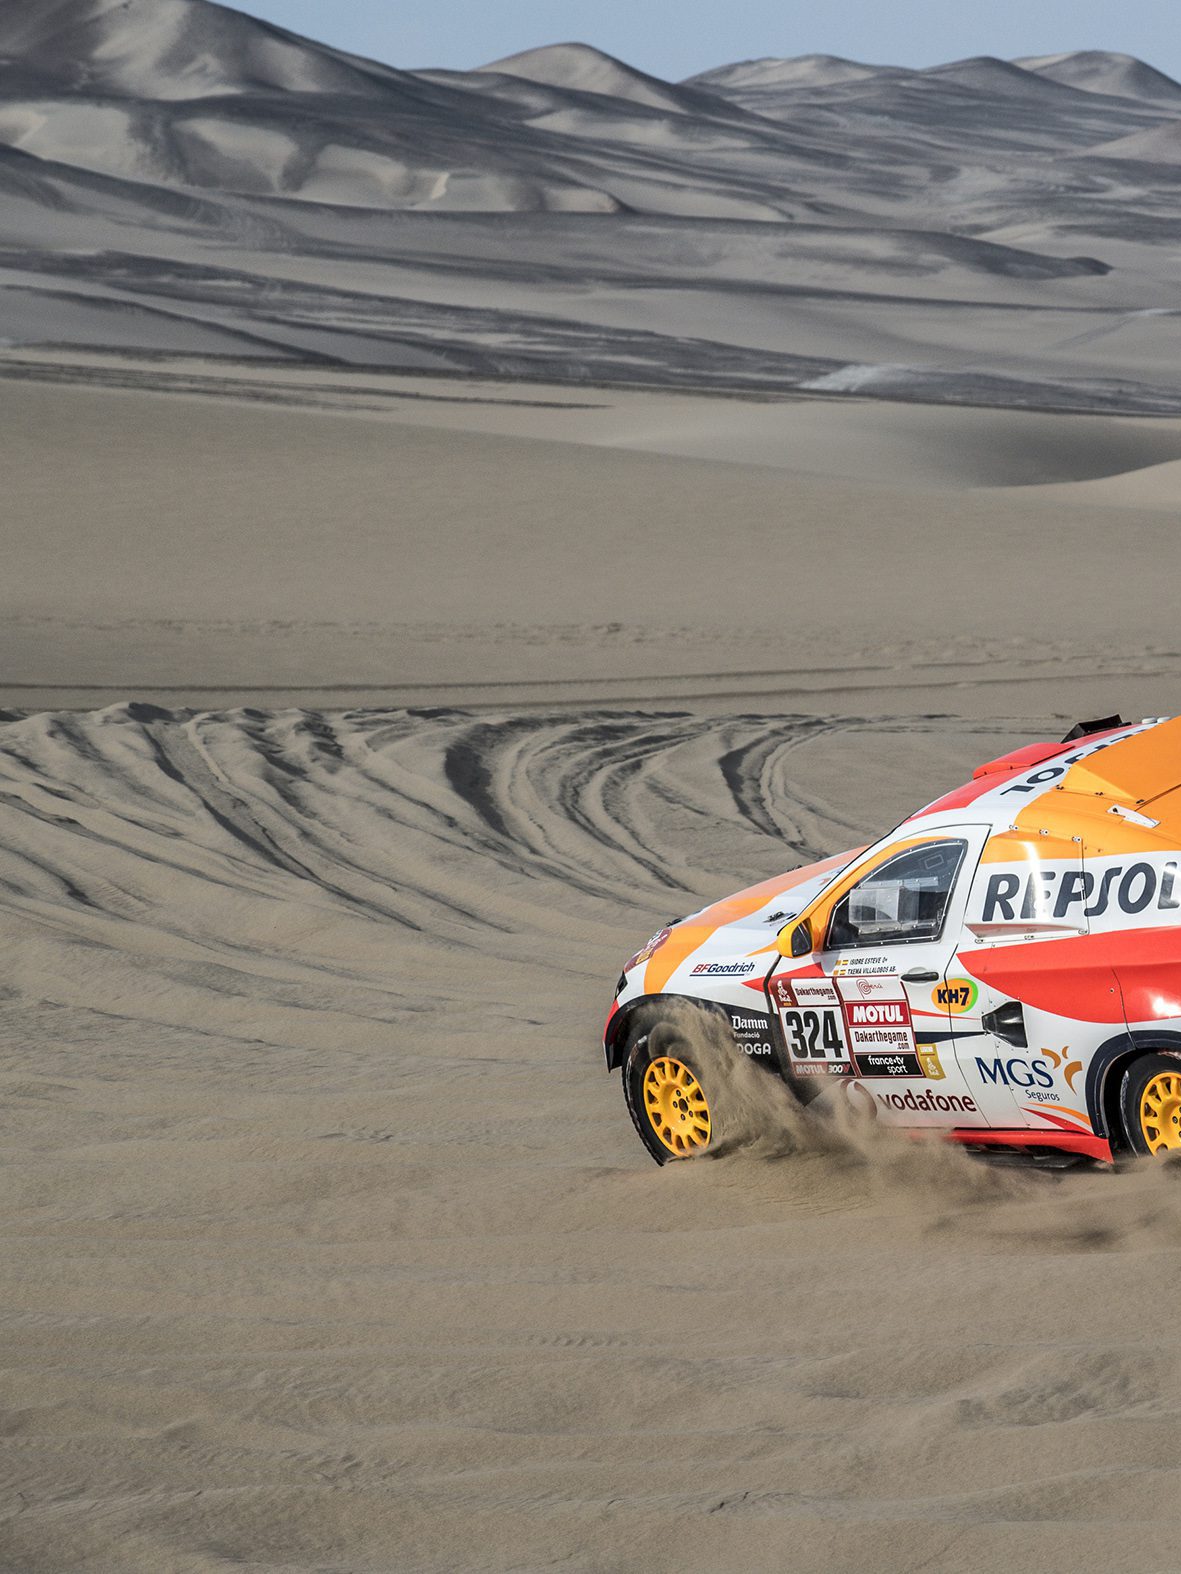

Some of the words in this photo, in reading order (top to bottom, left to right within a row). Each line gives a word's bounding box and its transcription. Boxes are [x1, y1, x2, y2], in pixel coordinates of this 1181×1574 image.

[692, 962, 755, 973] BFGoodrich
[849, 957, 863, 966] ISIDRE
[864, 956, 880, 965] ESTEVE
[862, 966, 889, 975] VILLALOBOS
[853, 1005, 903, 1023] MOTUL
[731, 1015, 768, 1029] Damm
[786, 1011, 844, 1059] 324
[855, 1031, 908, 1045] Dakarthegame
[796, 1064, 826, 1074] MOTUL
[887, 1065, 908, 1076] sport
[975, 1057, 1054, 1088] MGS
[877, 1089, 977, 1112] vodafone
[1025, 1089, 1060, 1102] Seguros
